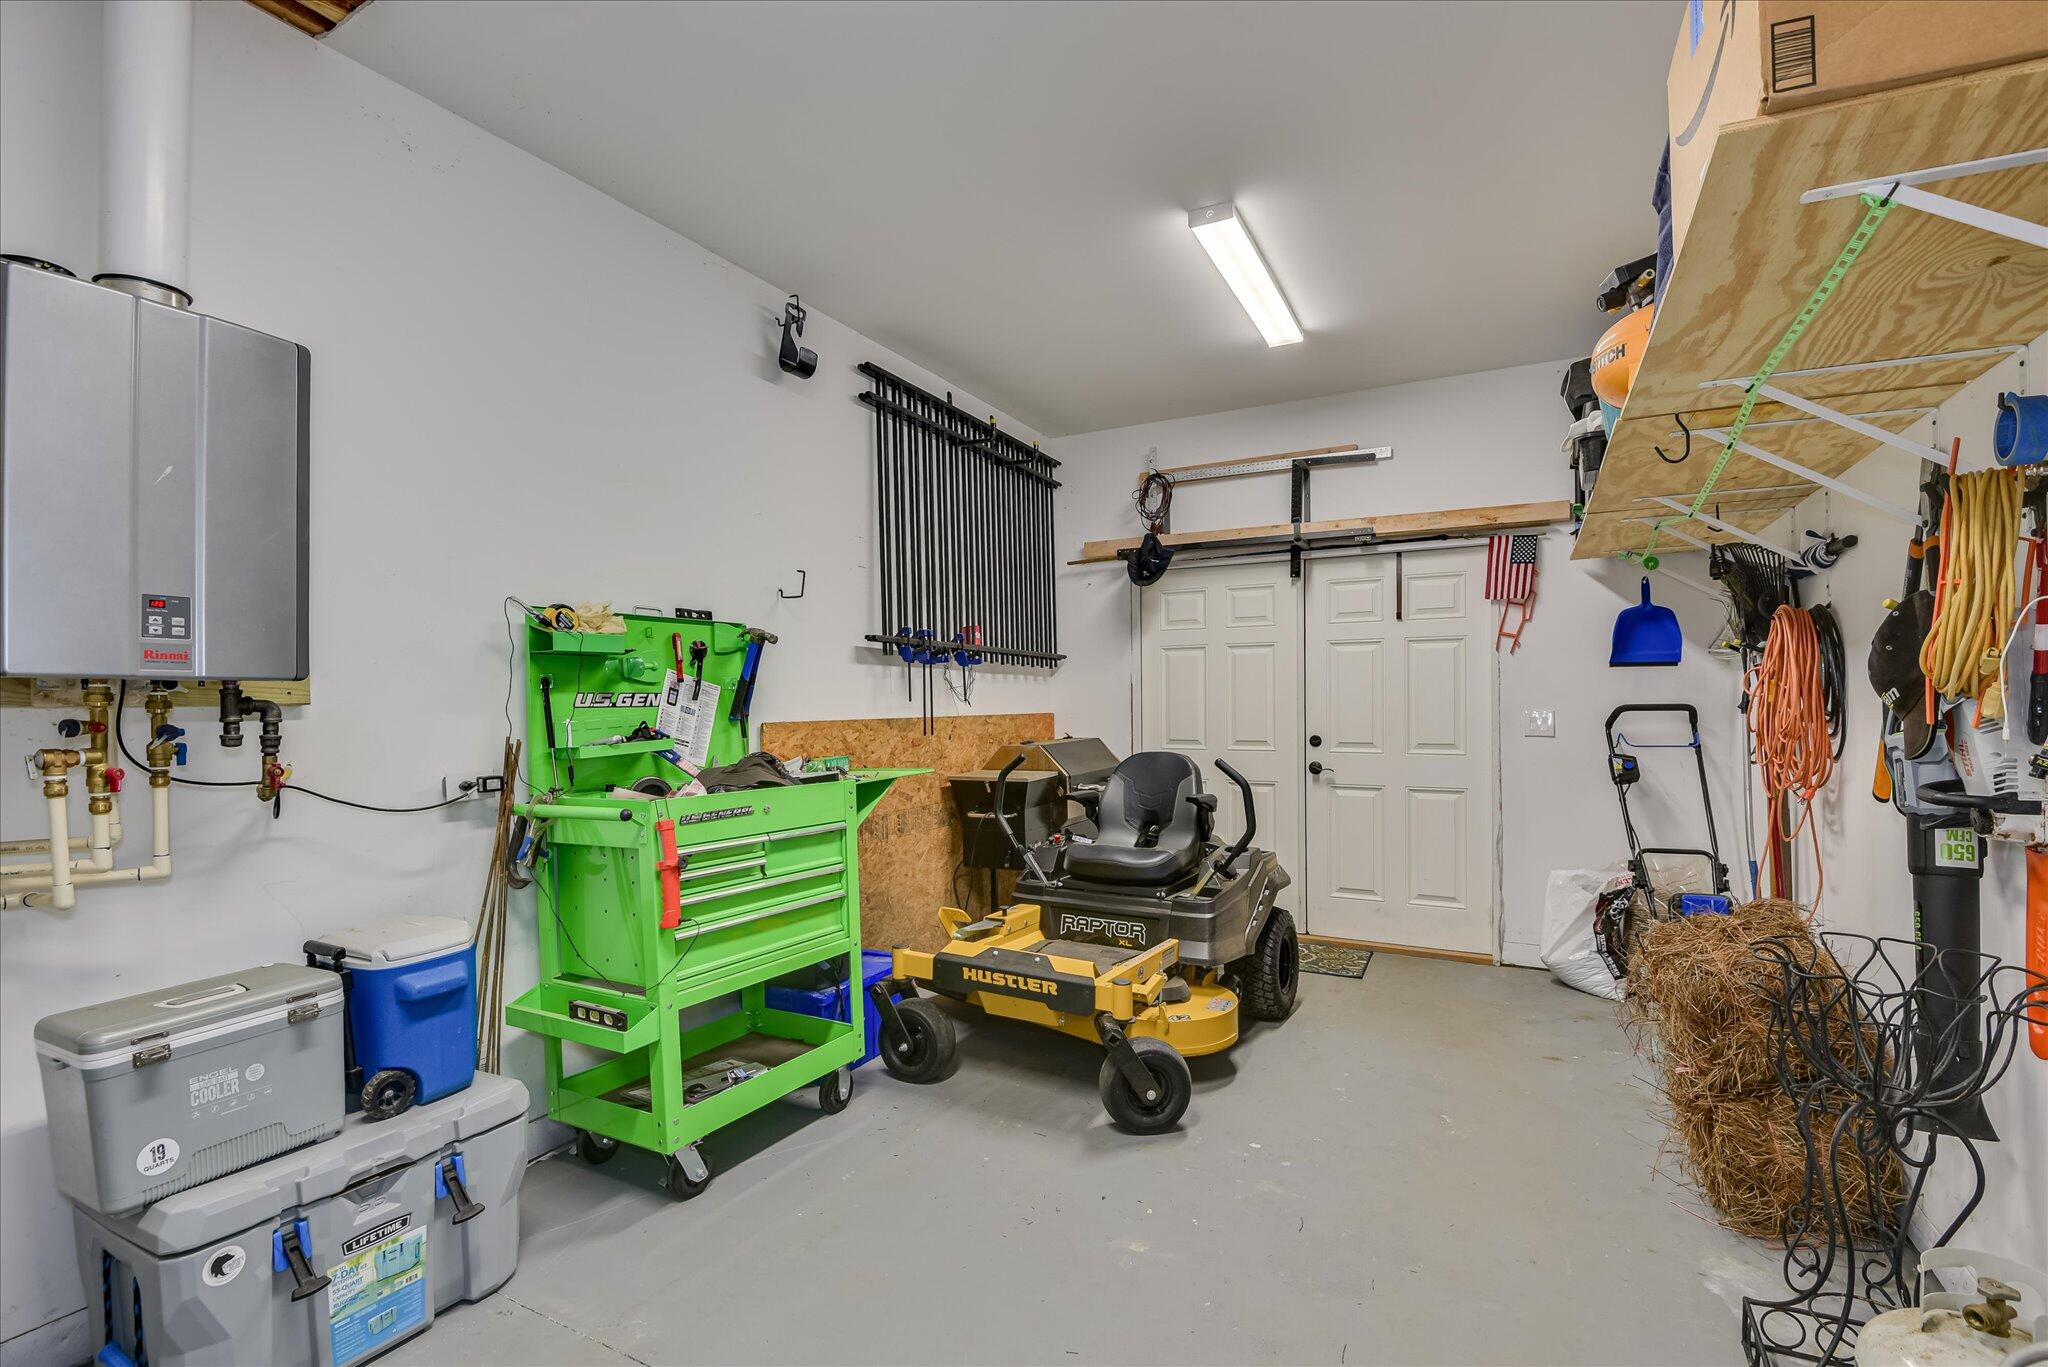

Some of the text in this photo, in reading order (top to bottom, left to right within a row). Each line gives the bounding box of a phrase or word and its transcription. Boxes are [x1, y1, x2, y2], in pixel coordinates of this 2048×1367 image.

[144, 648, 189, 660] Rinnai
[1946, 828, 1973, 843] CFM
[1940, 843, 1976, 863] 650
[1060, 913, 1146, 946] RAPTOR
[1118, 939, 1133, 947] XL
[962, 966, 1058, 996] HUSTLER
[190, 1079, 240, 1107] COOLER
[150, 1143, 166, 1163] 19
[143, 1156, 175, 1172] QUARTS
[352, 1220, 403, 1250] LIFETIME
[332, 1263, 361, 1284] 7-DAY
